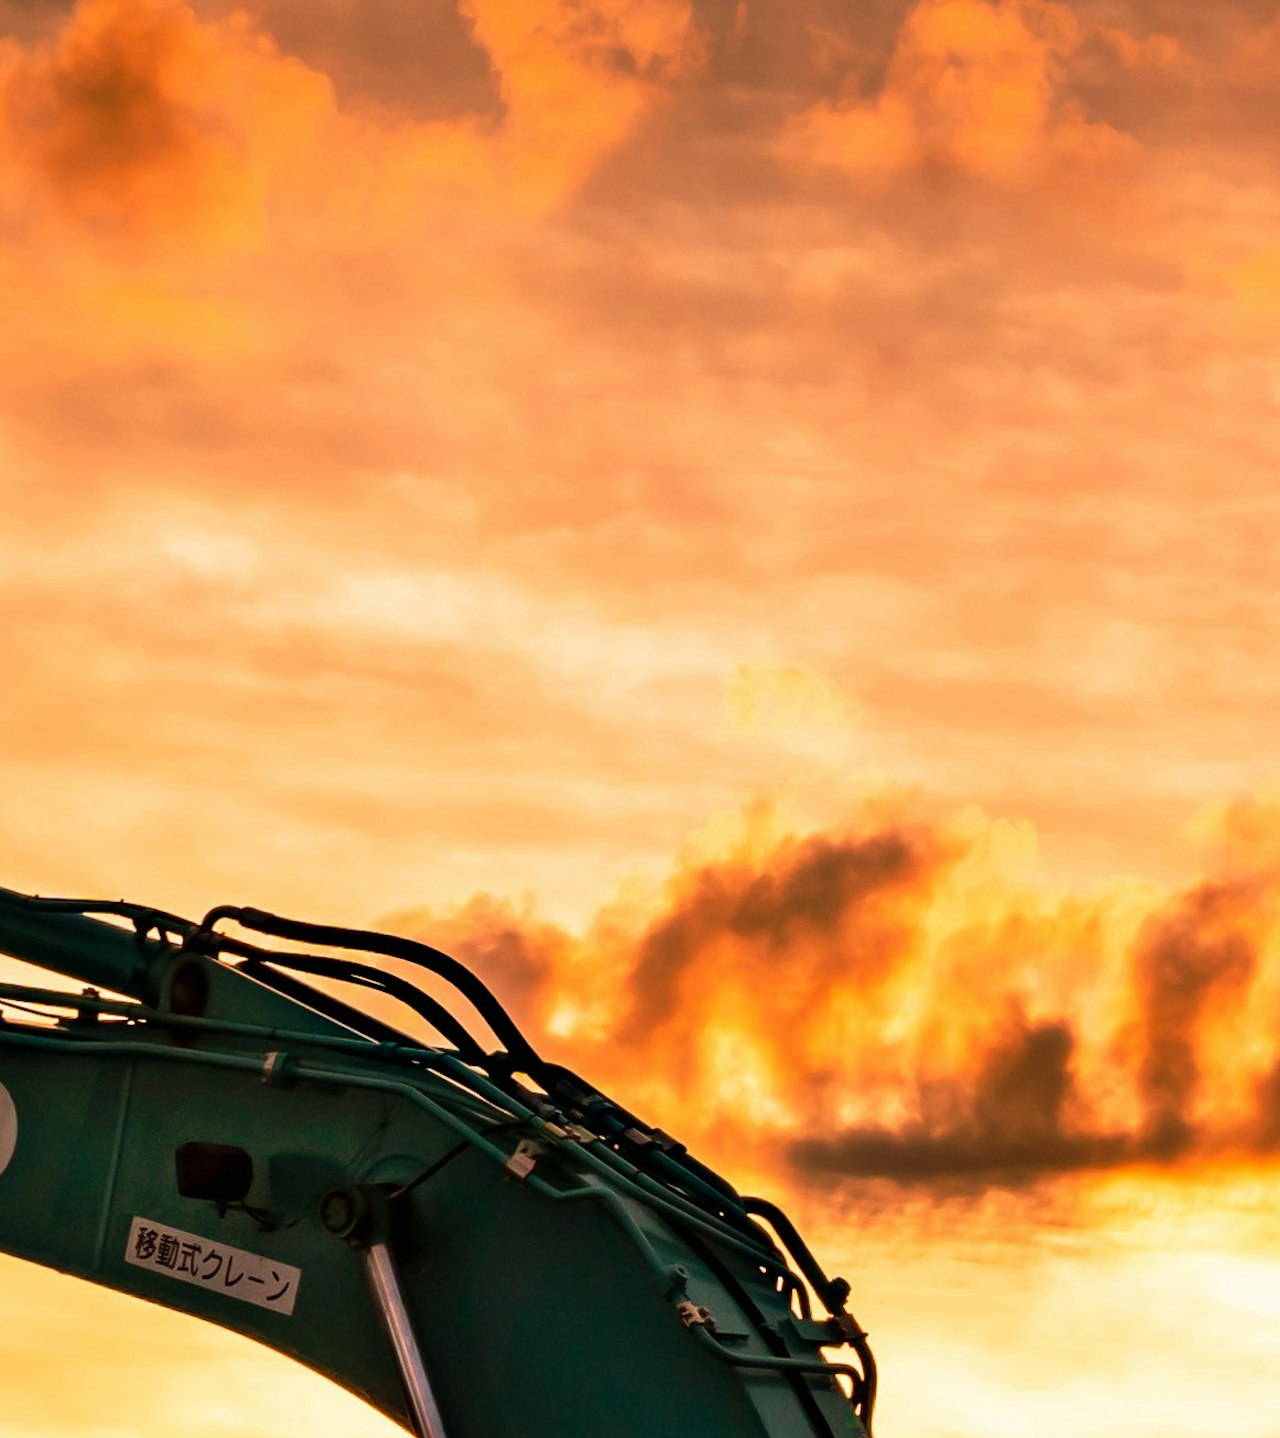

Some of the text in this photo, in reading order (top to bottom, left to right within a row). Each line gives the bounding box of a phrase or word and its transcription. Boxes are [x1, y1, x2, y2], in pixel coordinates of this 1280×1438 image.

[134, 1226, 290, 1301] 移動式クレーン
